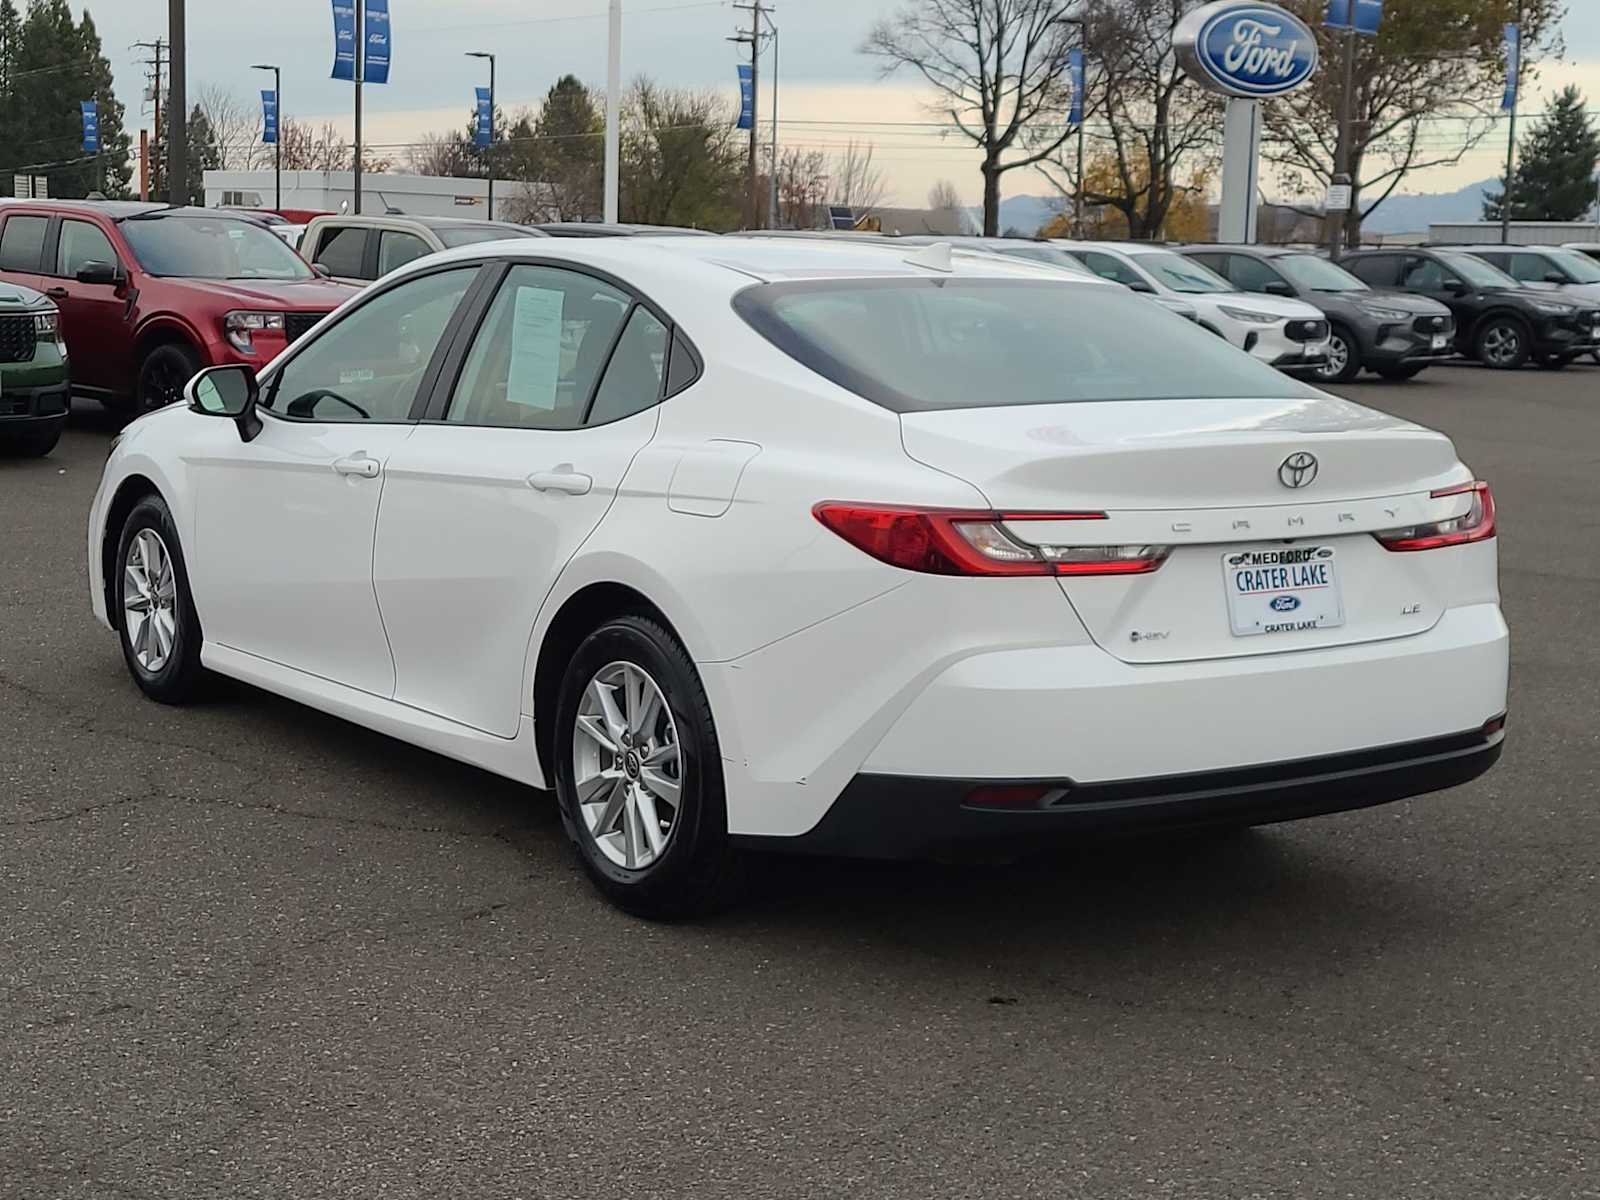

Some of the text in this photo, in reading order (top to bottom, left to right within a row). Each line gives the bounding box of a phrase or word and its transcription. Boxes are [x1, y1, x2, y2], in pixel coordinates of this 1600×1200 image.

[1225, 19, 1296, 77] Ford
[1172, 509, 1399, 532] CAMRY
[1252, 550, 1311, 565] MEDFORD
[1236, 564, 1328, 592] CRATER LAKE
[1275, 597, 1296, 611] Ford
[1402, 603, 1421, 615] LE
[1265, 620, 1318, 634] CRATER LAKE
